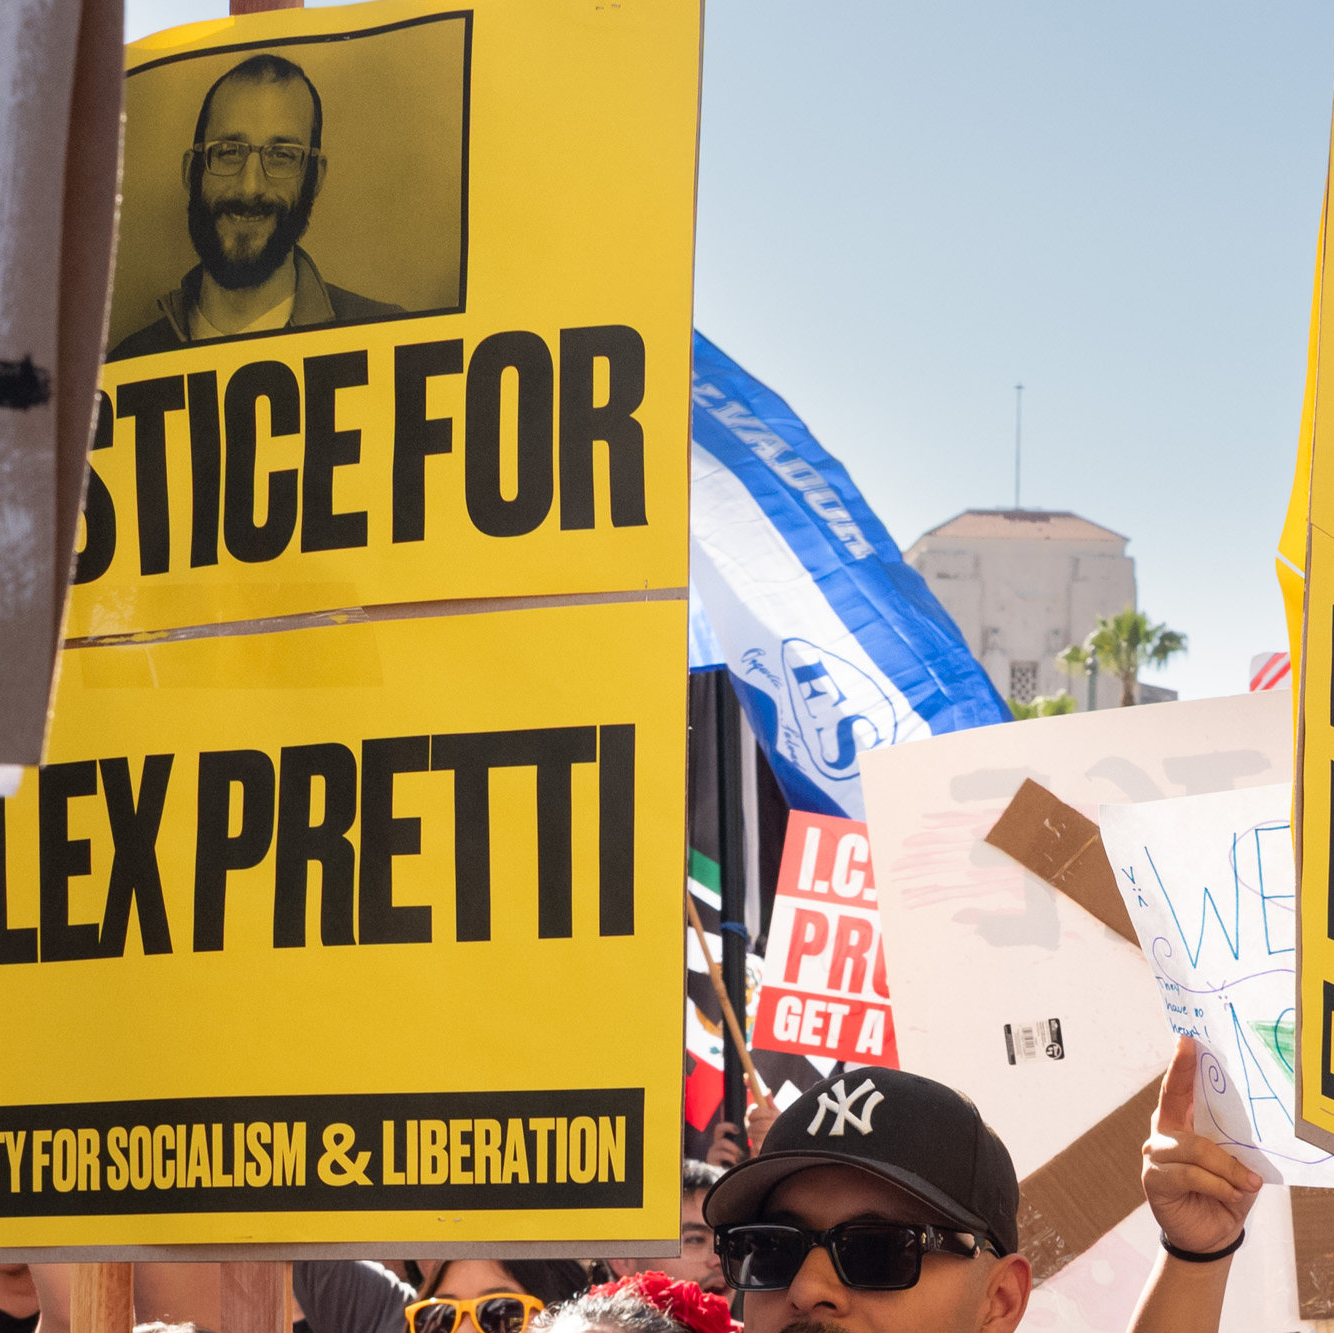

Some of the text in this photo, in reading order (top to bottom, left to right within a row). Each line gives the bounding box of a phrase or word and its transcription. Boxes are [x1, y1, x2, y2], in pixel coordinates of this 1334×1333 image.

[392, 324, 649, 544] FOR
[193, 723, 636, 953] PRETTI
[772, 994, 886, 1057] GET A
[807, 1078, 885, 1137] NY
[32, 1126, 101, 1192] FOR
[106, 1121, 307, 1191] SOCIALISM
[316, 1121, 375, 1186] &
[383, 1115, 627, 1185] LIBERATION
